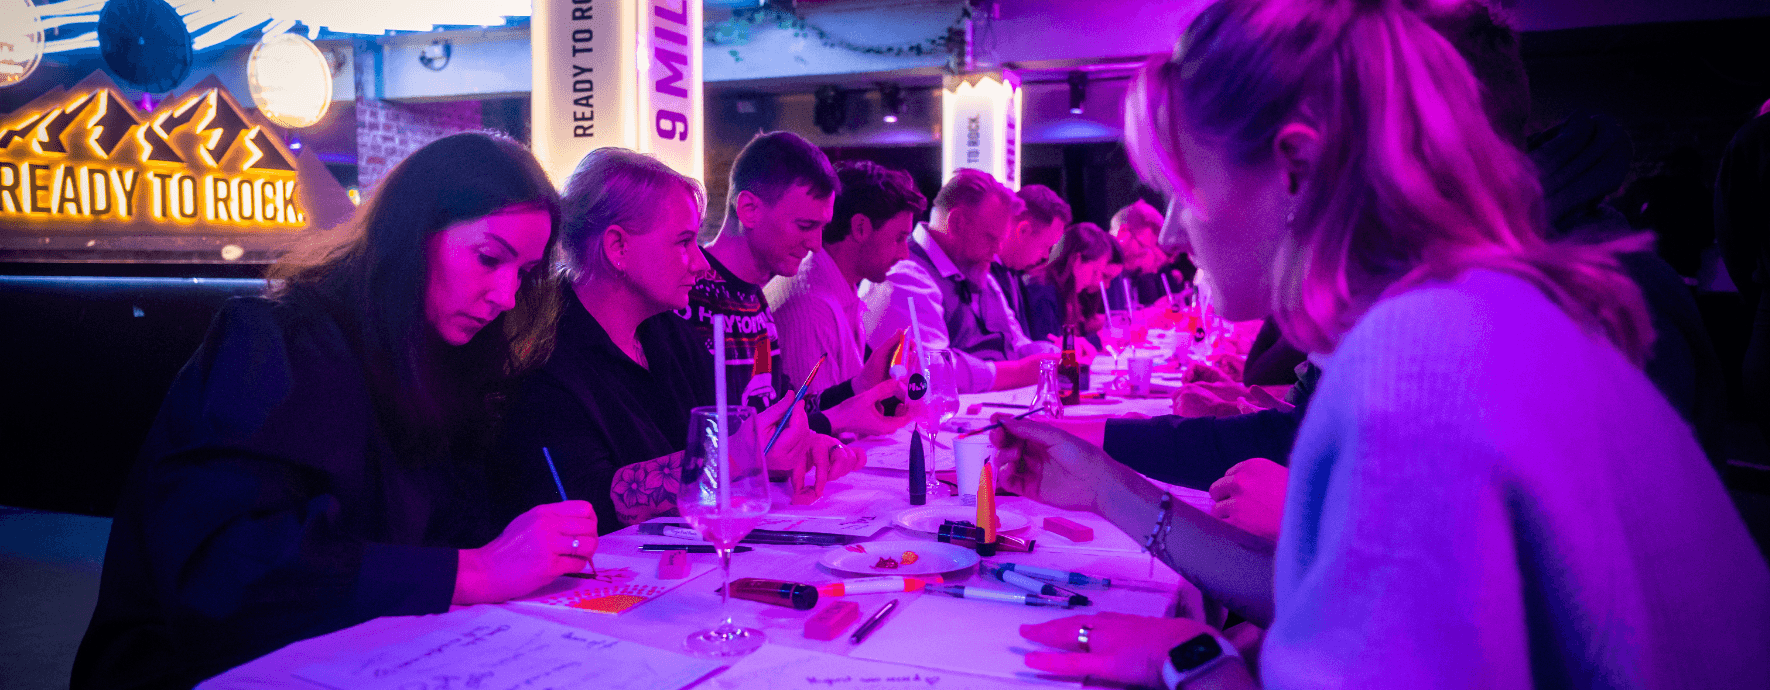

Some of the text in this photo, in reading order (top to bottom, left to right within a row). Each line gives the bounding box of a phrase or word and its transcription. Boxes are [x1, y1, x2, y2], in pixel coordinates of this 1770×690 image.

[571, 0, 594, 138] READY TO R
[655, 109, 689, 142] 9
[0, 161, 140, 217] READY
[148, 171, 198, 219] TO
